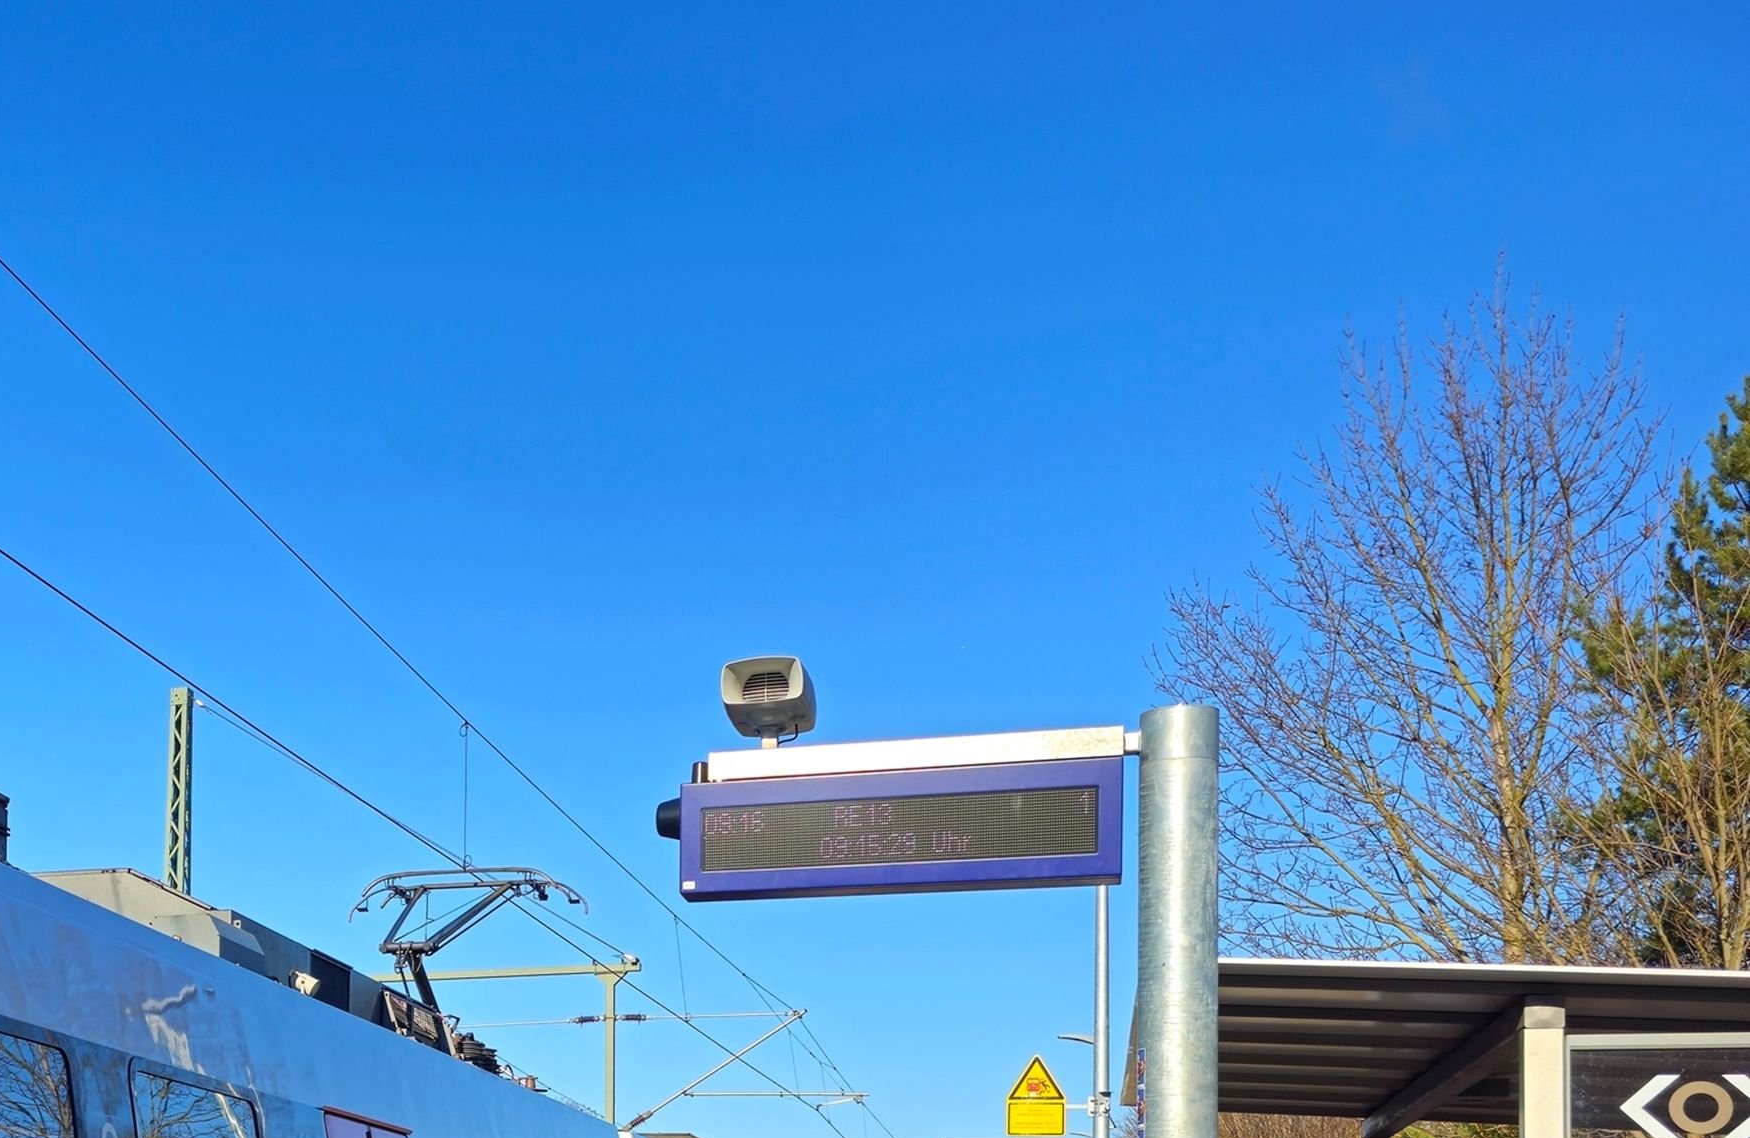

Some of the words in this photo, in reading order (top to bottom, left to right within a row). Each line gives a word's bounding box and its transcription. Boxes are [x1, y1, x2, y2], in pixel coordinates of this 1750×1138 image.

[705, 811, 764, 834] 09:16
[834, 803, 891, 827] RE13
[819, 832, 916, 858] 09:15:29
[932, 831, 971, 852] Uhr
